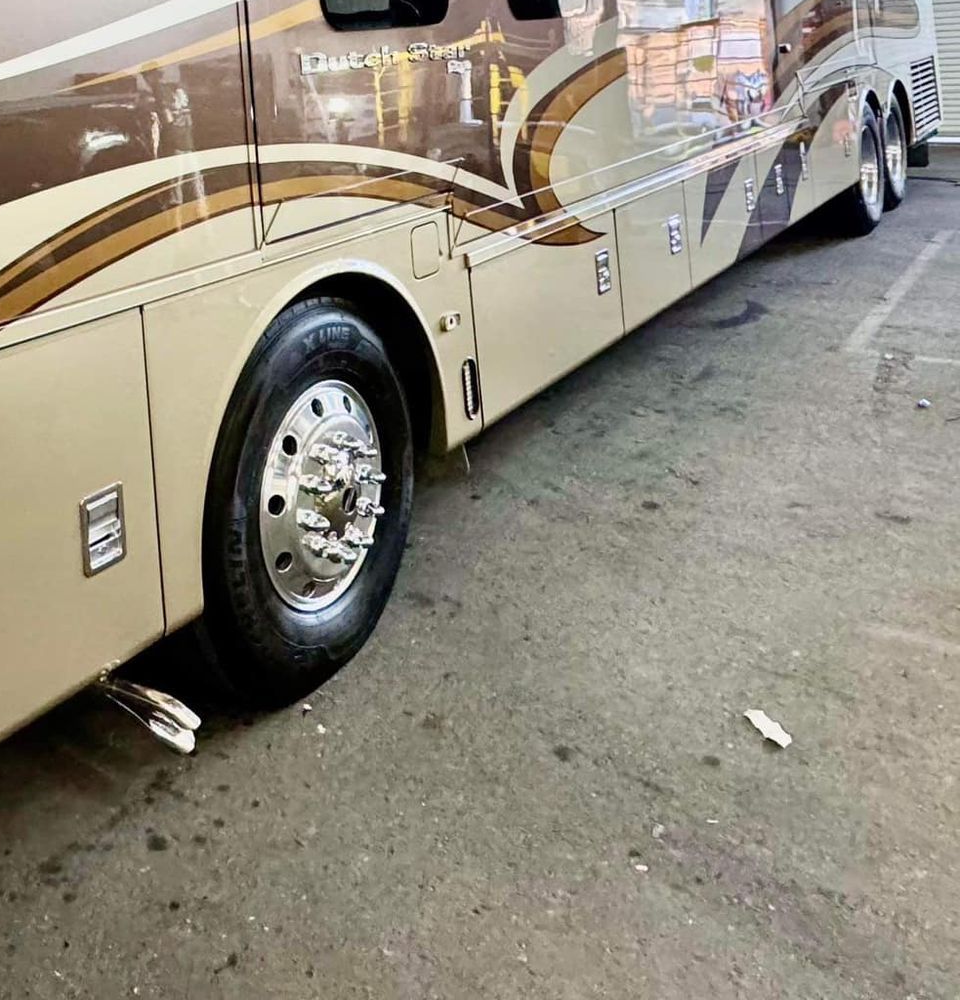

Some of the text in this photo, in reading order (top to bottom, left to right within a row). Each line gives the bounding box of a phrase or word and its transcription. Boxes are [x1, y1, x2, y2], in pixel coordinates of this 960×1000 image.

[300, 42, 470, 75] Dutch Star
[319, 325, 351, 346] LINE
